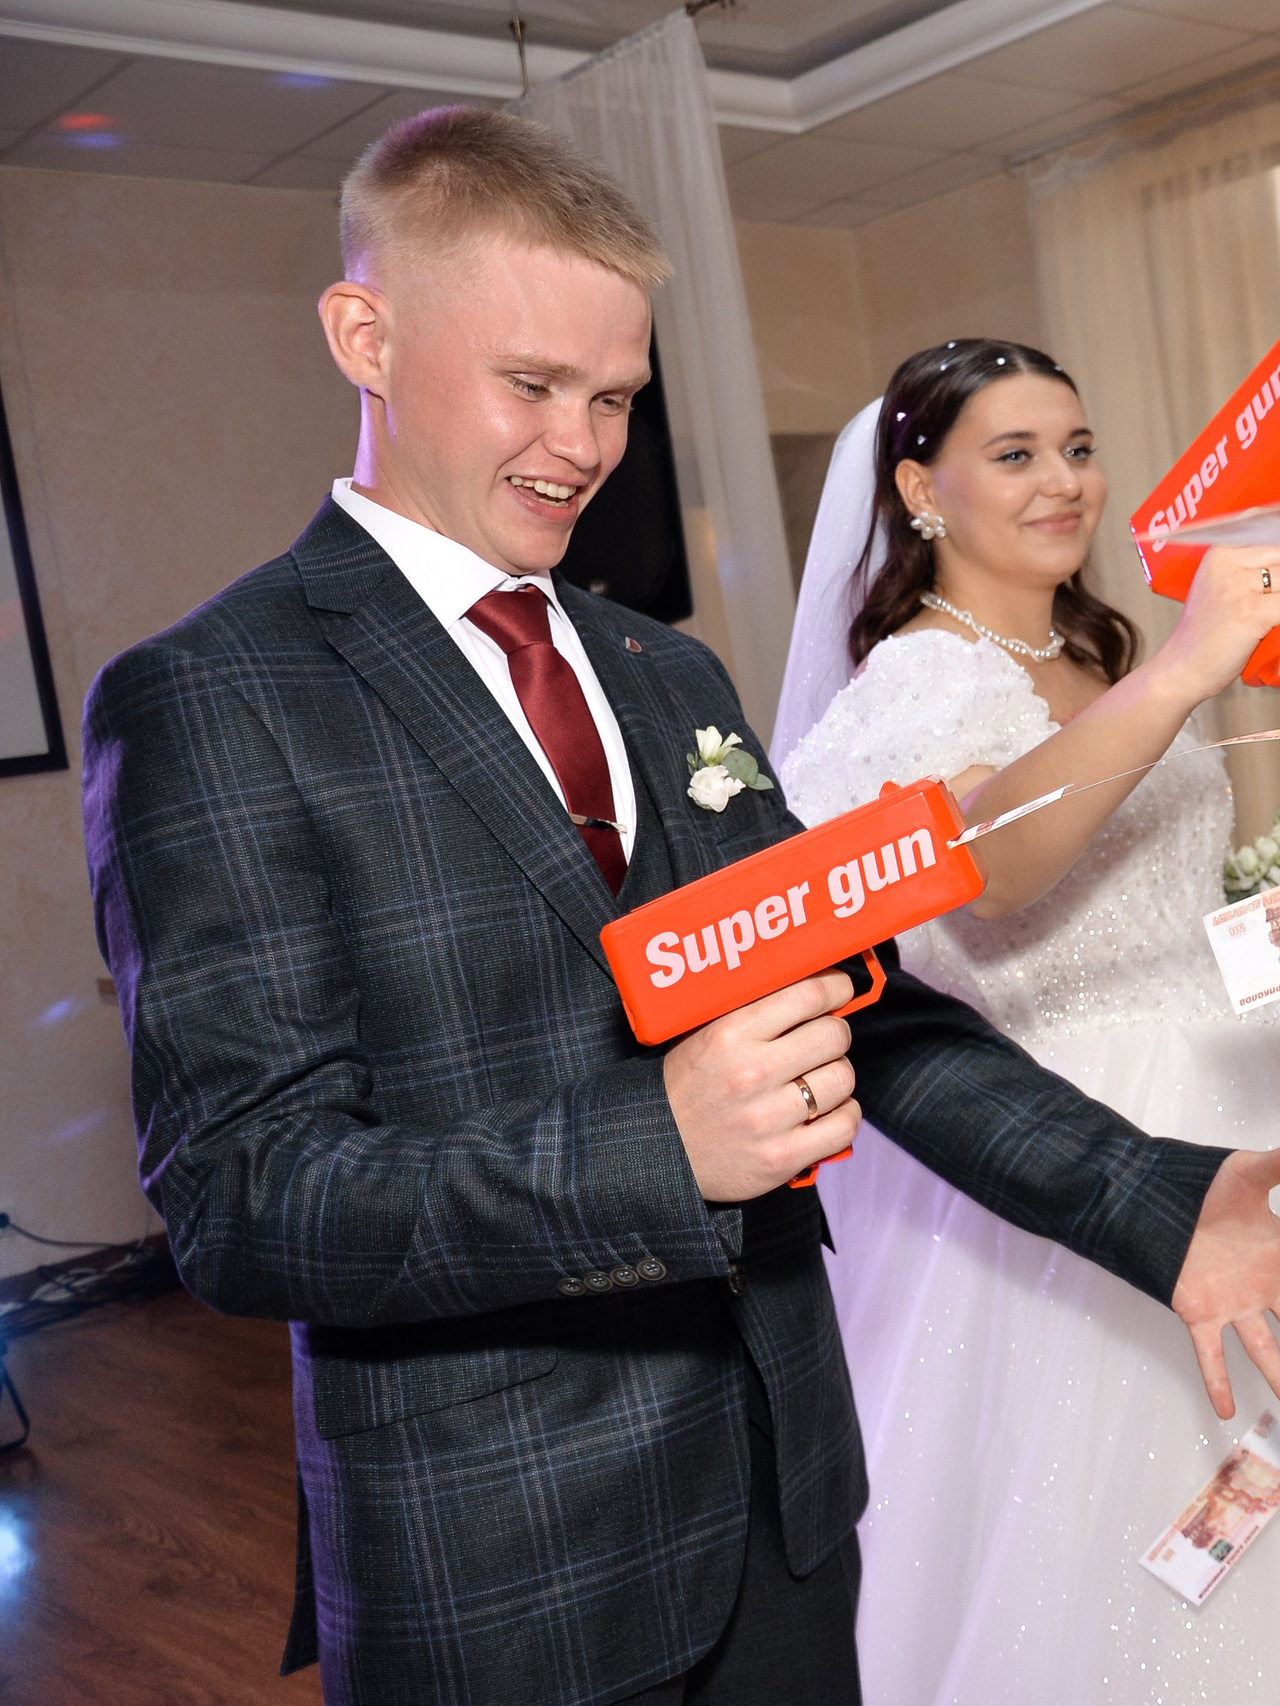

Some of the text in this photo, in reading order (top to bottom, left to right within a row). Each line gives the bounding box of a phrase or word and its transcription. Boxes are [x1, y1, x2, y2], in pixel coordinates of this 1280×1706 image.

[1148, 435, 1229, 553] Super
[645, 828, 936, 988] Super gun
